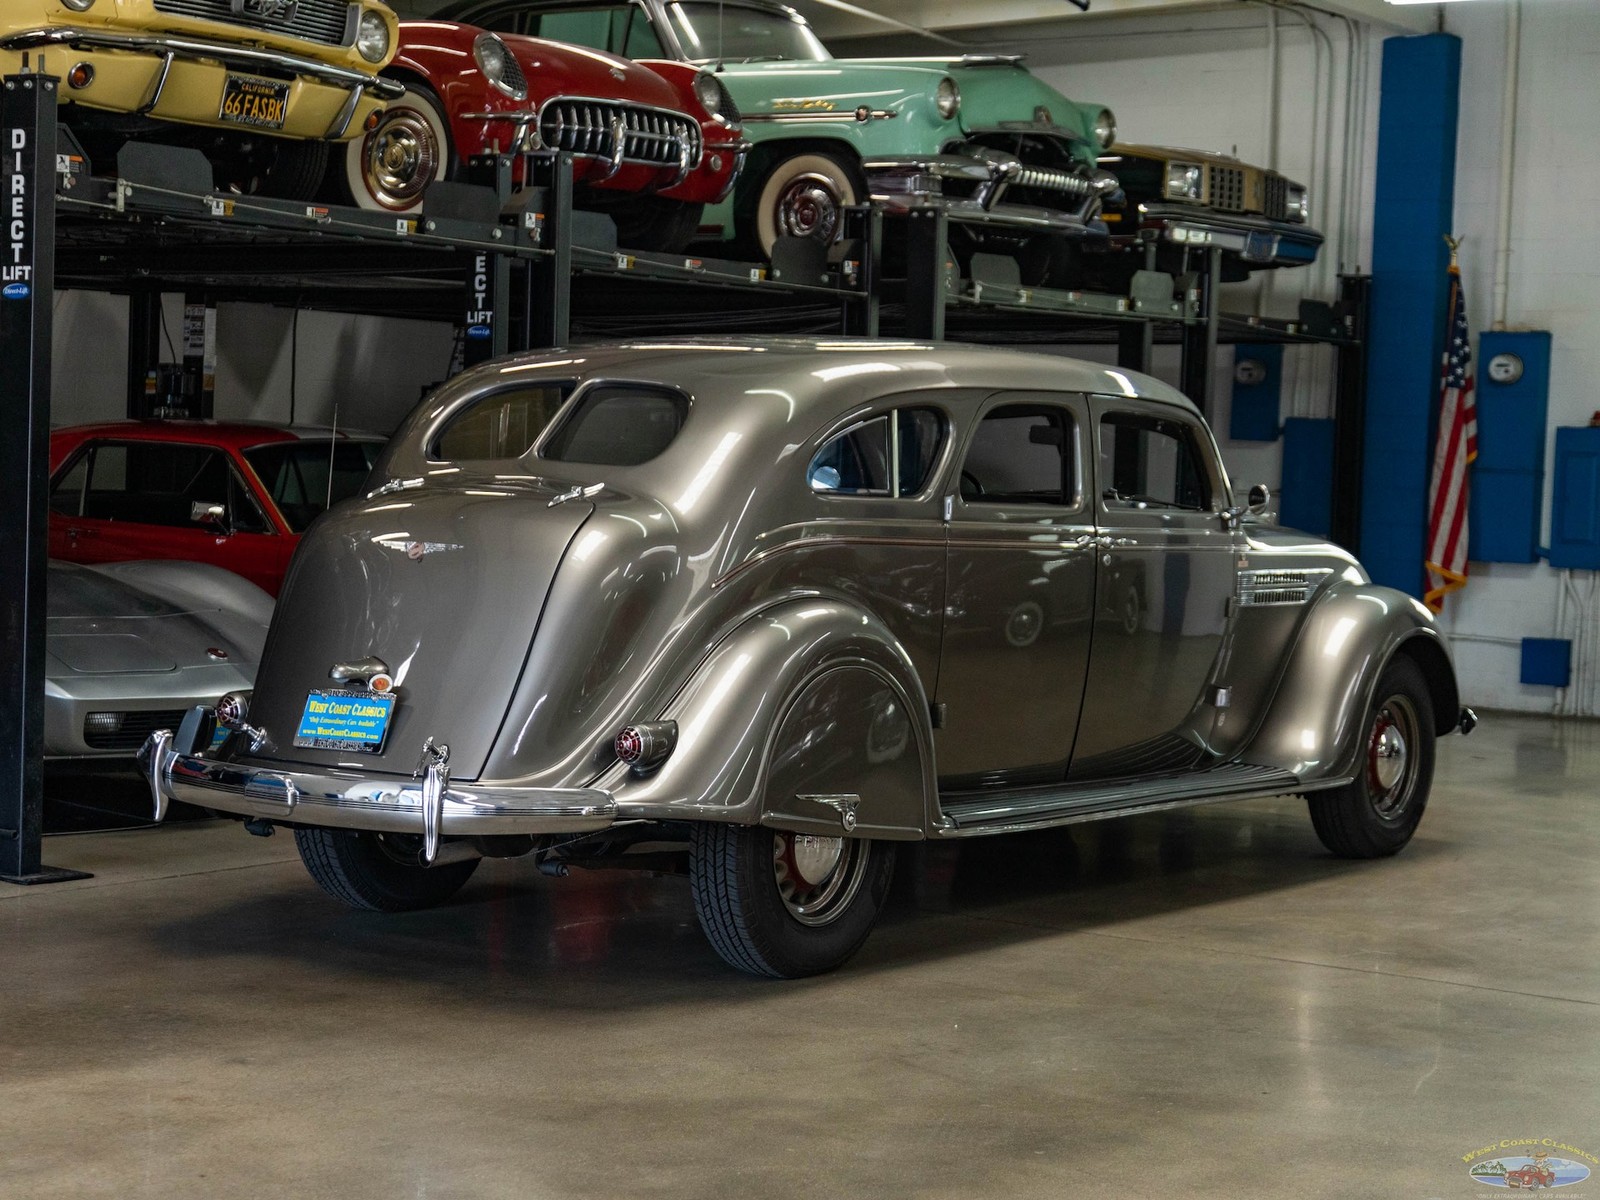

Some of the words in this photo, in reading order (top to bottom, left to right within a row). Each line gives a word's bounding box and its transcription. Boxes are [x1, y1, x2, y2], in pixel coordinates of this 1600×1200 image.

[241, 83, 275, 95] CALIFORNIA
[10, 128, 26, 263] DIRECT
[2, 265, 32, 280] LIFT
[467, 311, 493, 324] LIFT
[309, 700, 329, 713] WEST
[328, 702, 352, 715] COAST
[352, 703, 387, 718] CLASSICS
